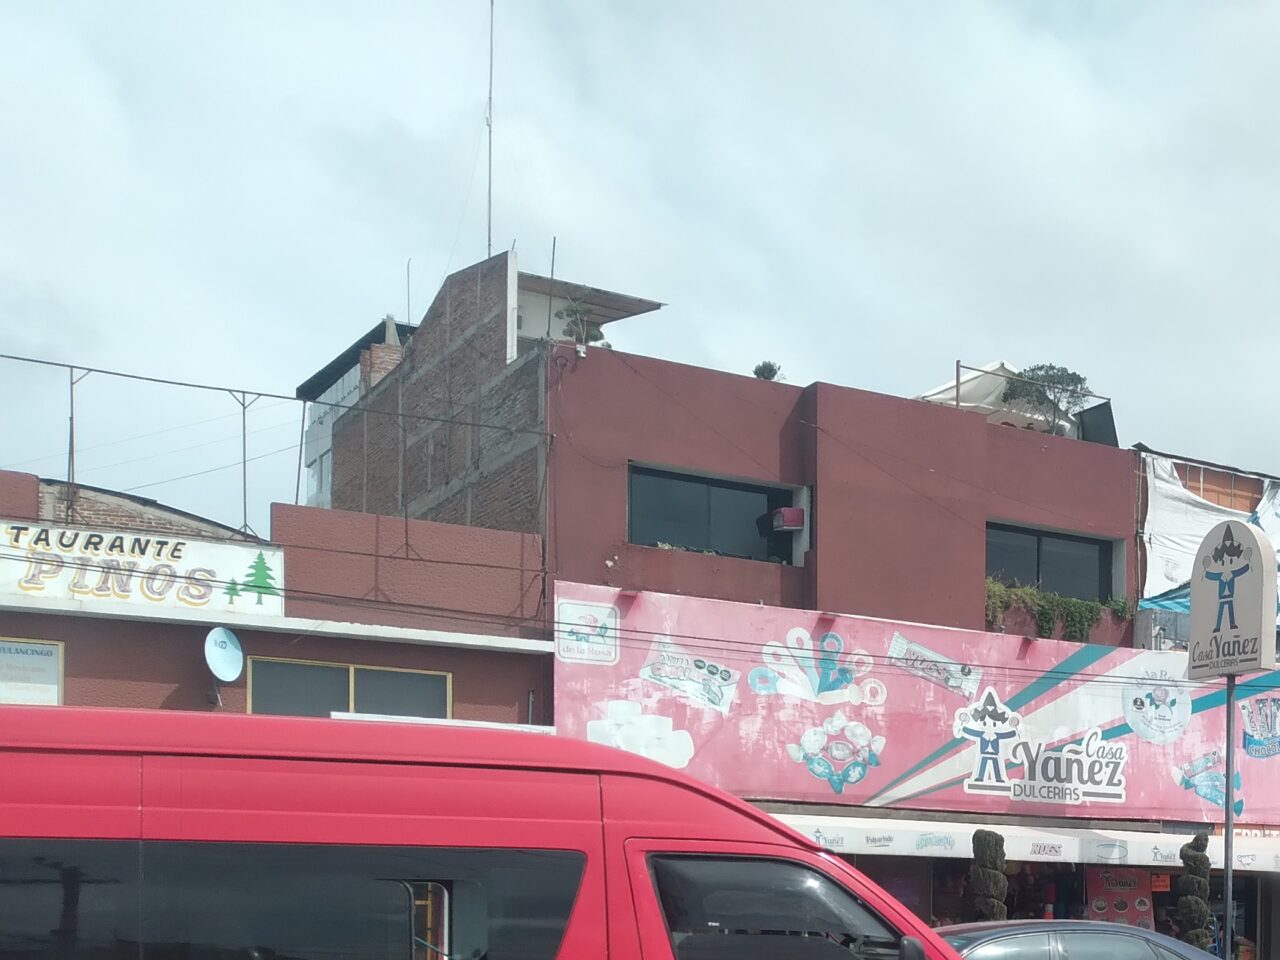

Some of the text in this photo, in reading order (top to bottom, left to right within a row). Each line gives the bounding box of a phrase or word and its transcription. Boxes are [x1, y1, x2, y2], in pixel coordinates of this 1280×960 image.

[20, 551, 218, 606] PINOS
[589, 646, 612, 657] Rosa
[1192, 634, 1259, 663] Casa Yañez
[1209, 658, 1239, 670] DULCERIAS
[1012, 731, 1124, 787] Casa Yañez
[1013, 784, 1080, 801] DULCERIAS
